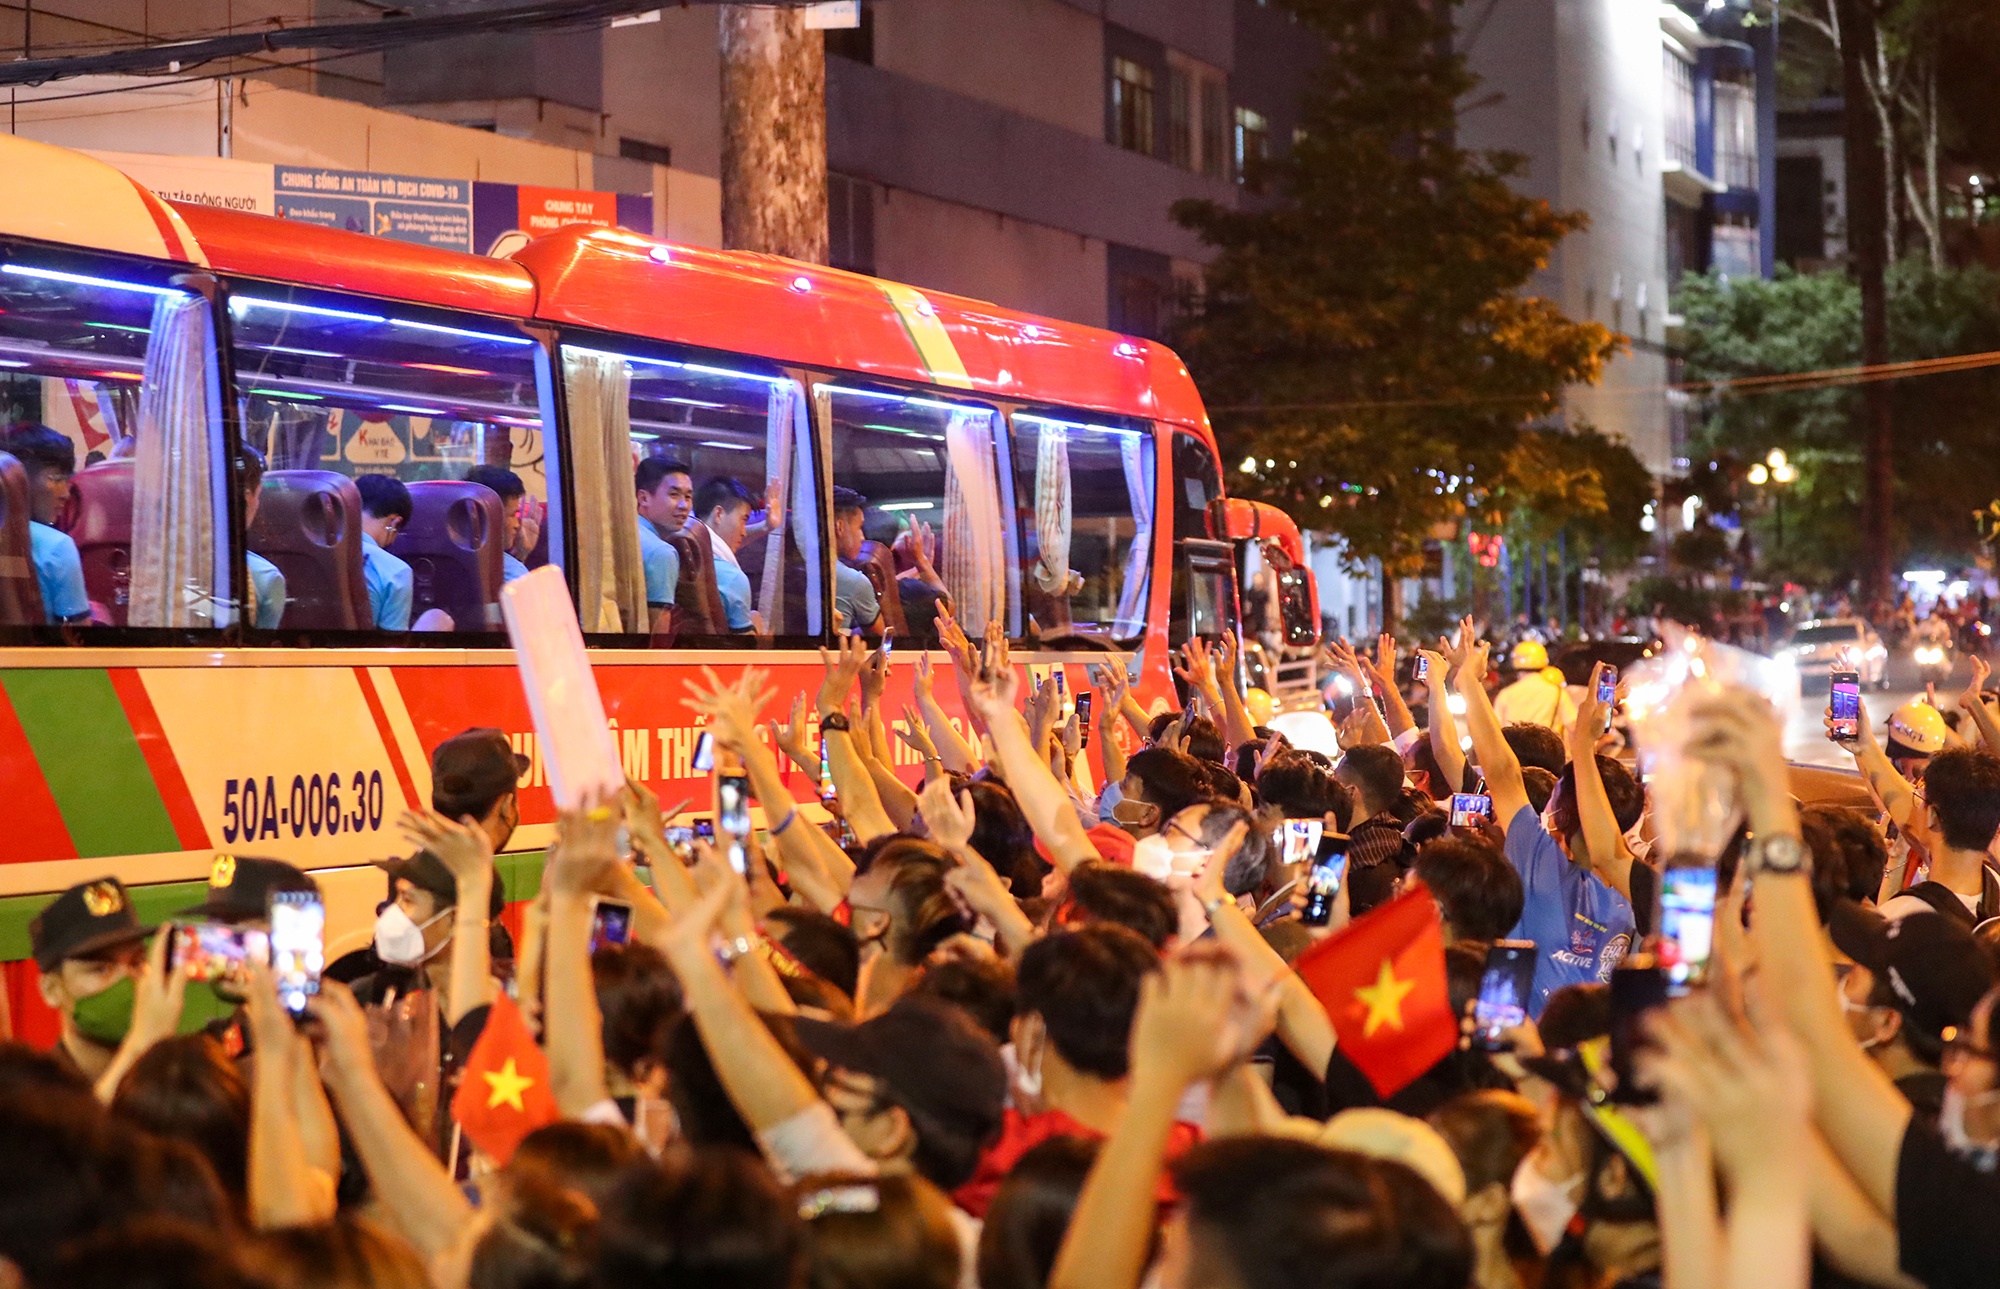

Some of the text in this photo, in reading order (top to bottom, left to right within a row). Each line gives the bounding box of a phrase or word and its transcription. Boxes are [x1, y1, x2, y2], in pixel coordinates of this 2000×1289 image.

[281, 171, 314, 189] CHUNG
[314, 169, 340, 191] SỐNG
[341, 176, 355, 192] AN
[355, 175, 380, 194] TOÀN
[419, 182, 459, 201] COVID-19
[544, 199, 594, 215] CHUNG TAY
[222, 769, 383, 845] 50A-006.30
[1552, 949, 1594, 969] ACTIVE
